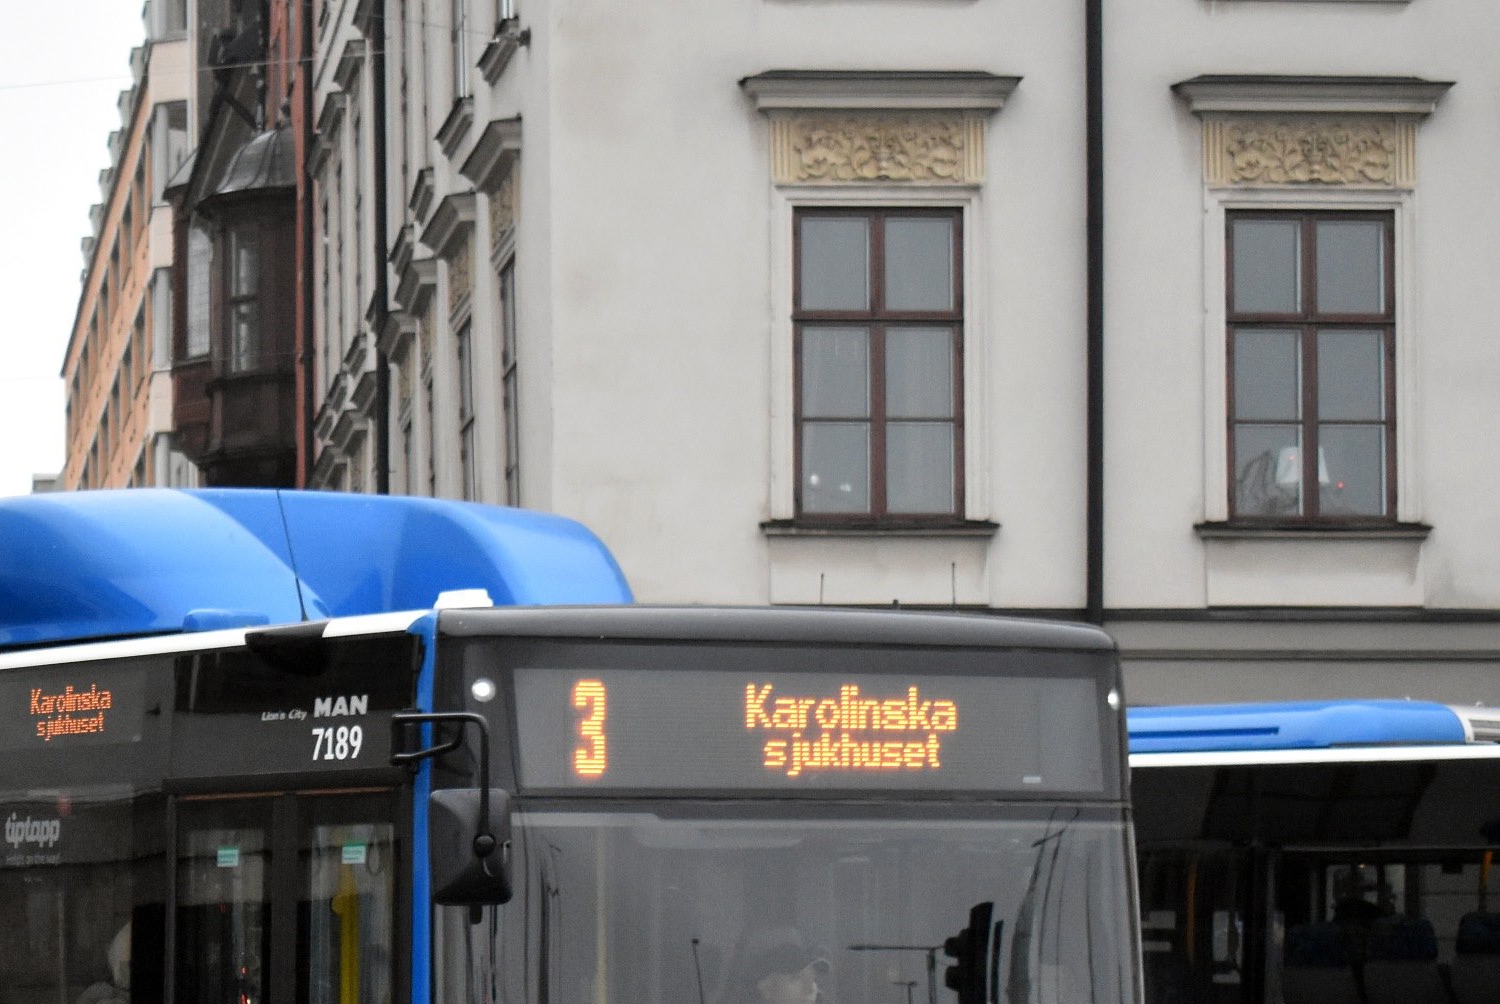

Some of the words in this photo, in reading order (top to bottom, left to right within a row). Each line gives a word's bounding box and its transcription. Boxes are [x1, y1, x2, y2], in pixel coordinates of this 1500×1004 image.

[31, 684, 111, 714] Karolinska
[313, 695, 368, 718] MAN
[746, 684, 957, 730] Karolinska
[37, 712, 104, 741] sjukhuset
[311, 725, 362, 760] 7189
[575, 681, 606, 774] 3
[763, 733, 940, 775] sjukhuset
[5, 812, 60, 849] tiptapp
